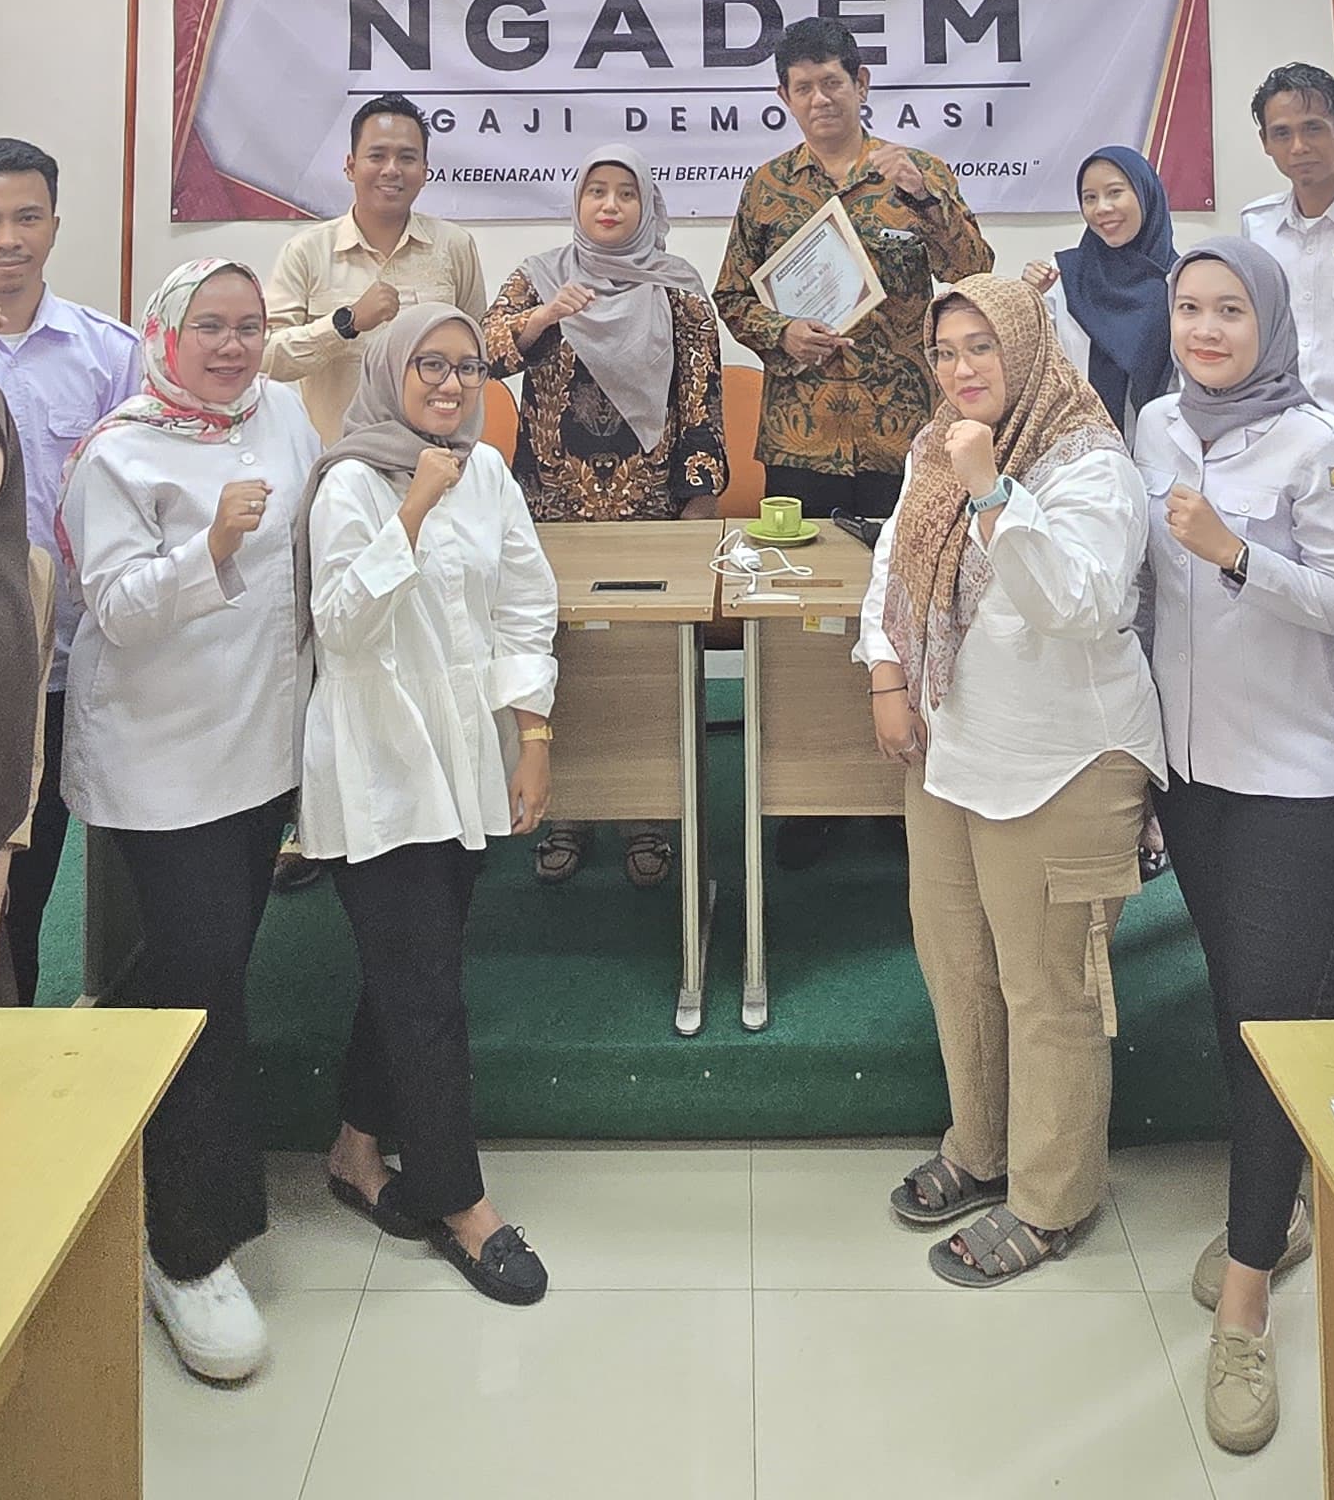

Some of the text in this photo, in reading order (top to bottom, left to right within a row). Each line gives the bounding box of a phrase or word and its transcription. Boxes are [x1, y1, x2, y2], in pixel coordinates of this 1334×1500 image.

[431, 102, 993, 134] GAJI DEMORASI
[452, 167, 555, 182] KEBENARAN
[675, 166, 754, 181] BERTAHA
[947, 161, 1028, 177] MOKRASI
